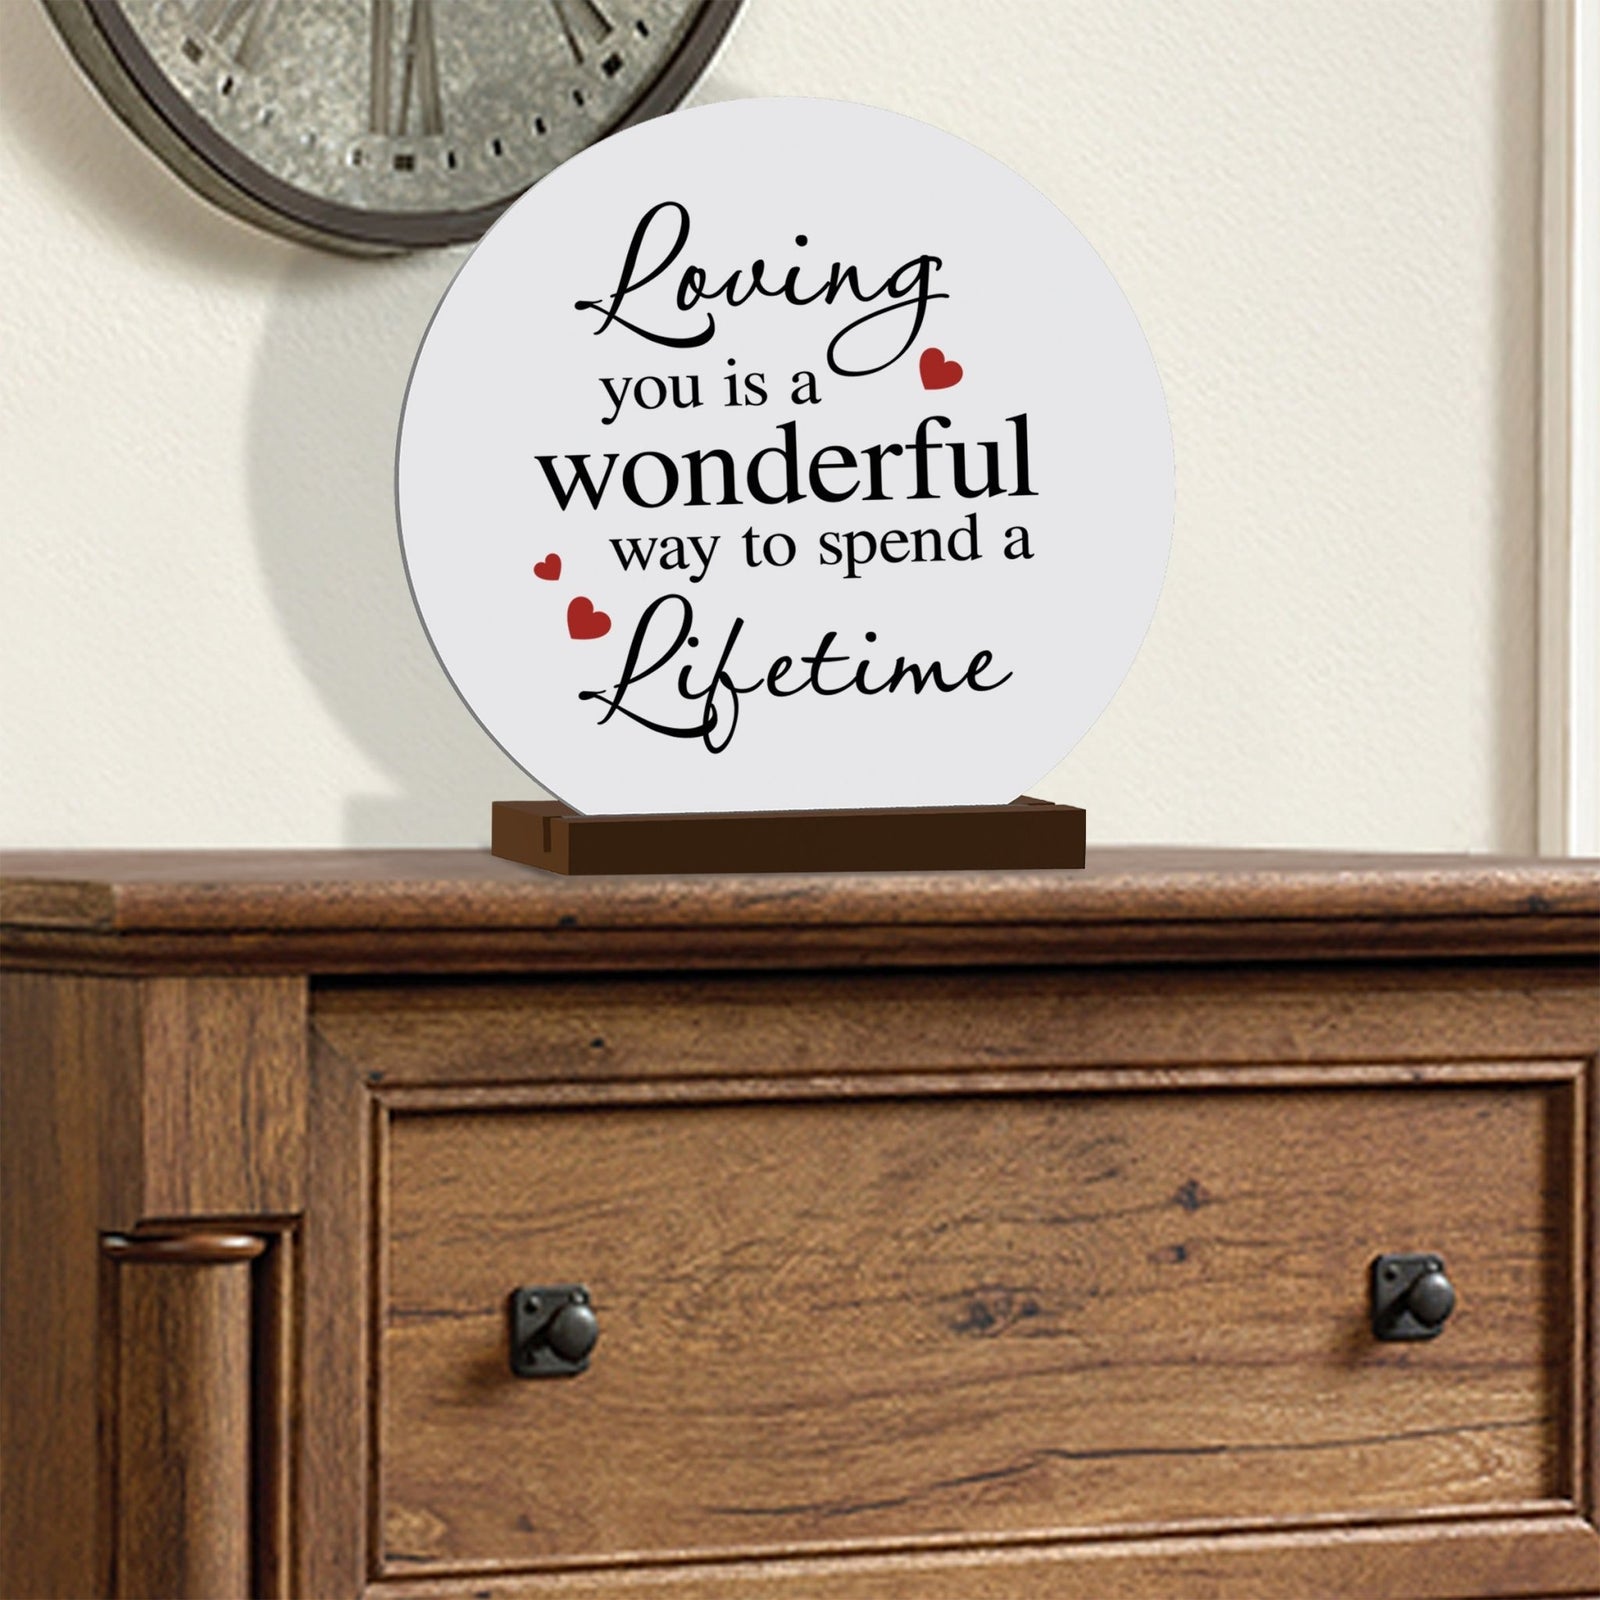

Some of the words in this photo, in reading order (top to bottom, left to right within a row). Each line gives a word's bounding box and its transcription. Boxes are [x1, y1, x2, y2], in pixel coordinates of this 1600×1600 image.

[575, 201, 949, 377] Loving
[599, 376, 703, 425] you
[724, 358, 767, 406] is
[791, 371, 821, 404] a
[534, 413, 1039, 511] wonderful
[609, 536, 720, 583] way
[742, 527, 796, 567] to
[820, 513, 982, 579] spend
[1004, 526, 1034, 559] a
[579, 594, 1013, 754] Lifetime
